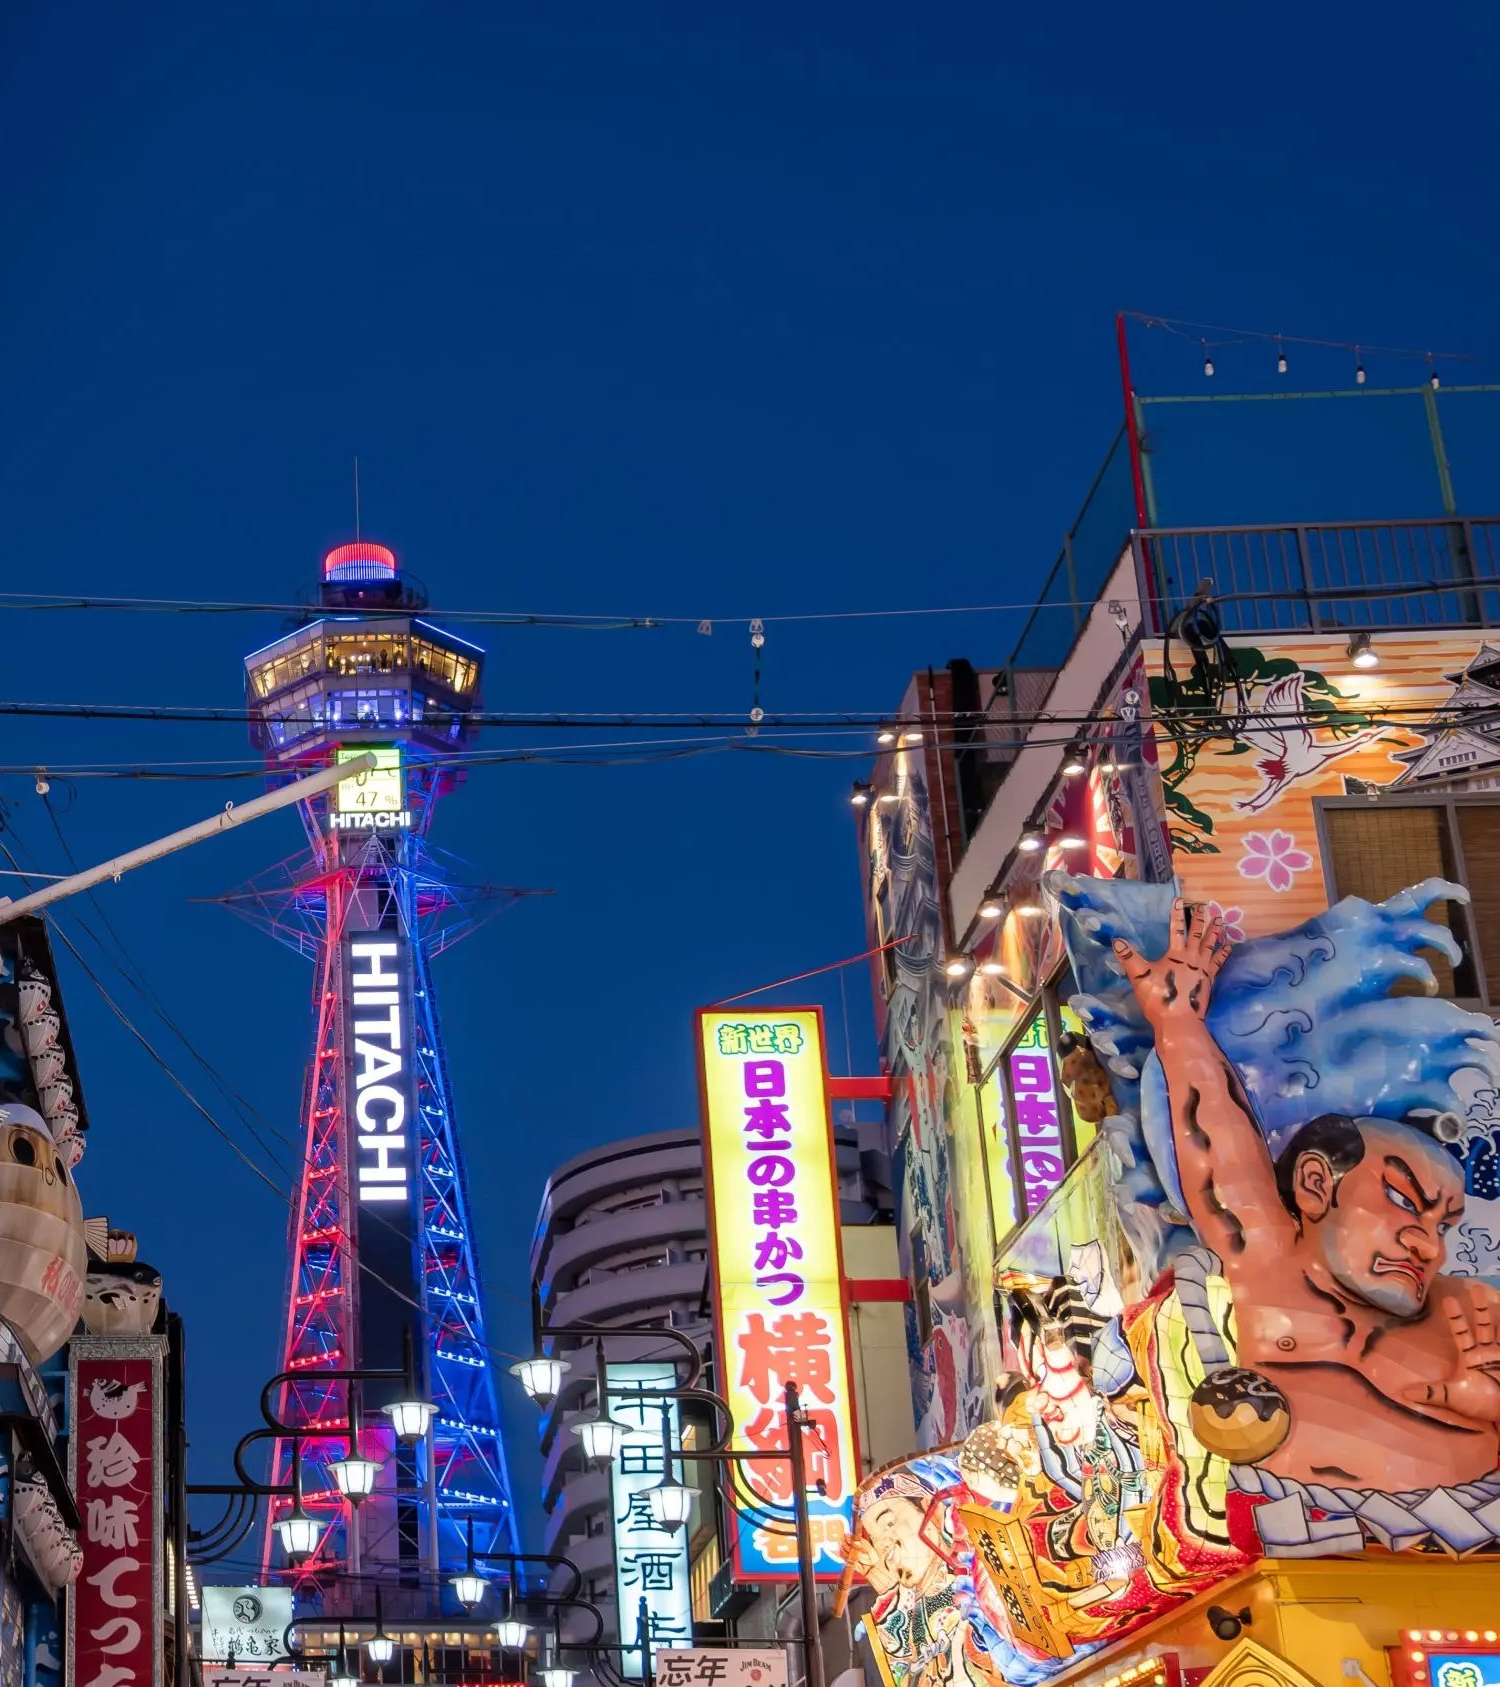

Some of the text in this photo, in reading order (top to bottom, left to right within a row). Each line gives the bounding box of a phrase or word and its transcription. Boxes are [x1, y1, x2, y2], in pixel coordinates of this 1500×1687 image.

[329, 811, 411, 828] HITACHI
[351, 942, 408, 1202] HITACHI
[718, 1022, 802, 1055] 新世界
[742, 1060, 803, 1307] 日本一の串かつ
[737, 1311, 843, 1504] 横綱
[658, 1655, 729, 1687] 忘年
